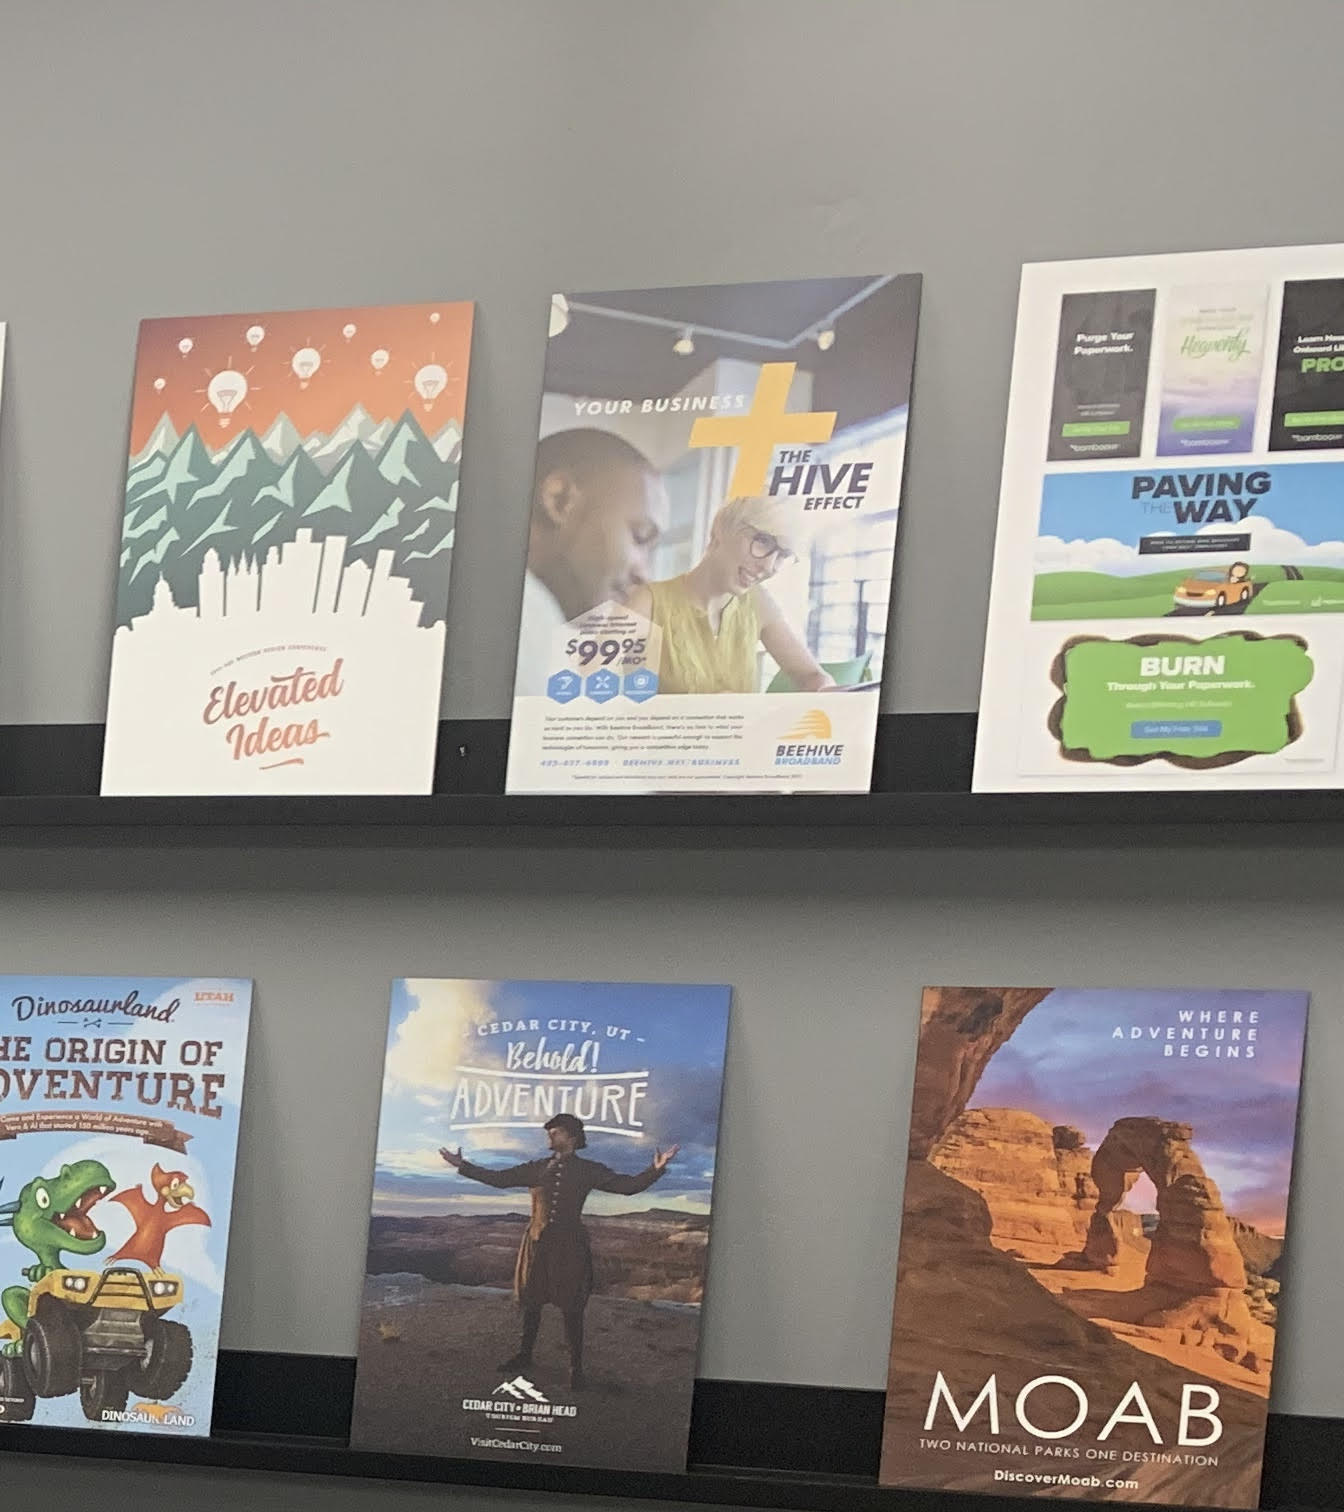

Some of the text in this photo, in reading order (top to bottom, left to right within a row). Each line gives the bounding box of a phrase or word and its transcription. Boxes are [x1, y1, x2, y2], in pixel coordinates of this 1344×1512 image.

[1077, 332, 1134, 343] Purge Your
[1074, 345, 1134, 355] Paperwork.
[1301, 356, 1344, 373] PRO
[574, 394, 745, 416] YOUR BUSINESS
[779, 450, 811, 463] THE
[769, 462, 873, 496] HIVE
[1131, 471, 1272, 500] PAVING
[803, 496, 864, 511] EFFECT
[1173, 498, 1257, 524] WAY
[1140, 655, 1225, 677] BURN
[203, 658, 344, 725] Elevated
[1108, 680, 1255, 692] Through Your Paperwork.
[226, 716, 330, 761] Ideas
[776, 745, 844, 757] BEEHIVE
[774, 756, 841, 766] BROADBAND
[194, 992, 234, 1002] UTAH
[12, 990, 180, 1023] Dinosaurland
[1179, 1010, 1259, 1024] WHERE
[477, 1019, 631, 1041] CEDAR CITY, UT
[1112, 1027, 1257, 1041] ADVENTURE
[45, 1037, 166, 1065] ORIGIN
[180, 1041, 223, 1067] OF
[506, 1037, 600, 1074] Behold!
[1164, 1045, 1255, 1058] BEGINS
[450, 1077, 648, 1127] ADVENTURE
[36, 1113, 73, 1121] Experience
[81, 1113, 103, 1121] World
[112, 1116, 147, 1126] Adventure
[463, 1399, 577, 1417] CEDAR CITY BRIAN HEAD
[923, 1370, 1223, 1447] MOAB
[164, 1414, 195, 1426] LAND
[470, 1436, 562, 1453] VisitCedarCity.com
[919, 1438, 1219, 1467] TWO NATIONAL PARKS ONE DESTINATION
[994, 1469, 1138, 1490] DiscoverMoab.com
